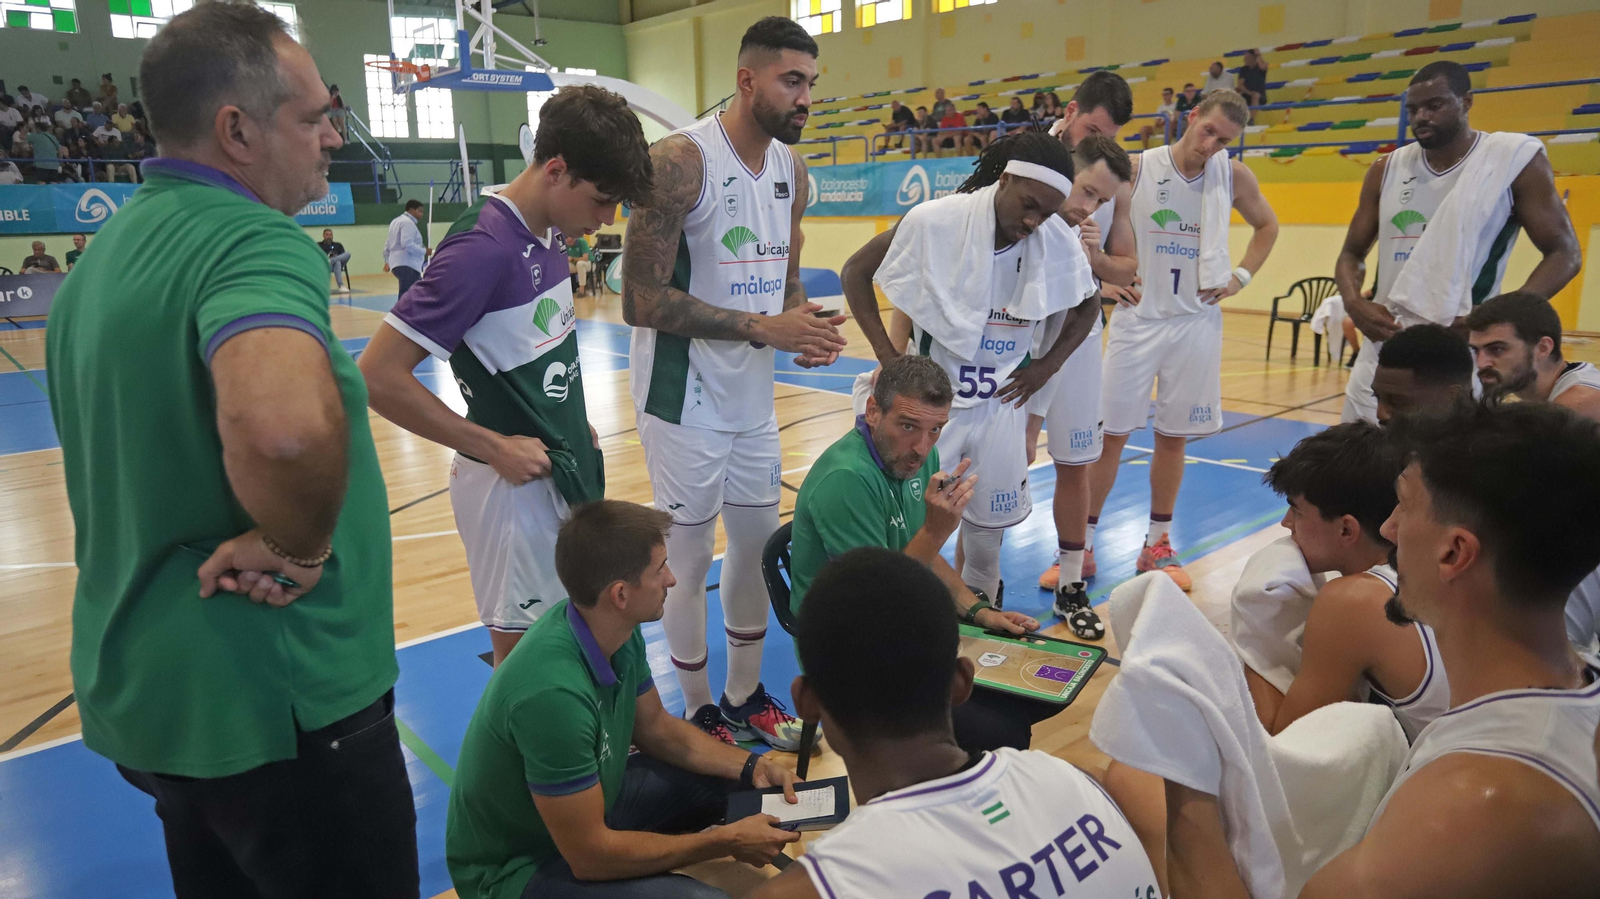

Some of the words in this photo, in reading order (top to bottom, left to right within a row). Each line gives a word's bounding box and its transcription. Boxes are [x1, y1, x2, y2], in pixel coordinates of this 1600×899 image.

[490, 73, 523, 84] SYSTEM
[820, 177, 869, 191] baloncesto
[1178, 223, 1201, 234] Unic
[1170, 268, 1181, 295] 1
[980, 334, 1017, 356] laga
[957, 365, 998, 400] 55
[1070, 437, 1093, 451] laga
[996, 485, 1018, 503] má
[991, 499, 1018, 514] laga
[1060, 682, 1079, 699] UNICAJA
[1072, 659, 1096, 682] BALONCESTO
[922, 813, 1122, 899] RTER
